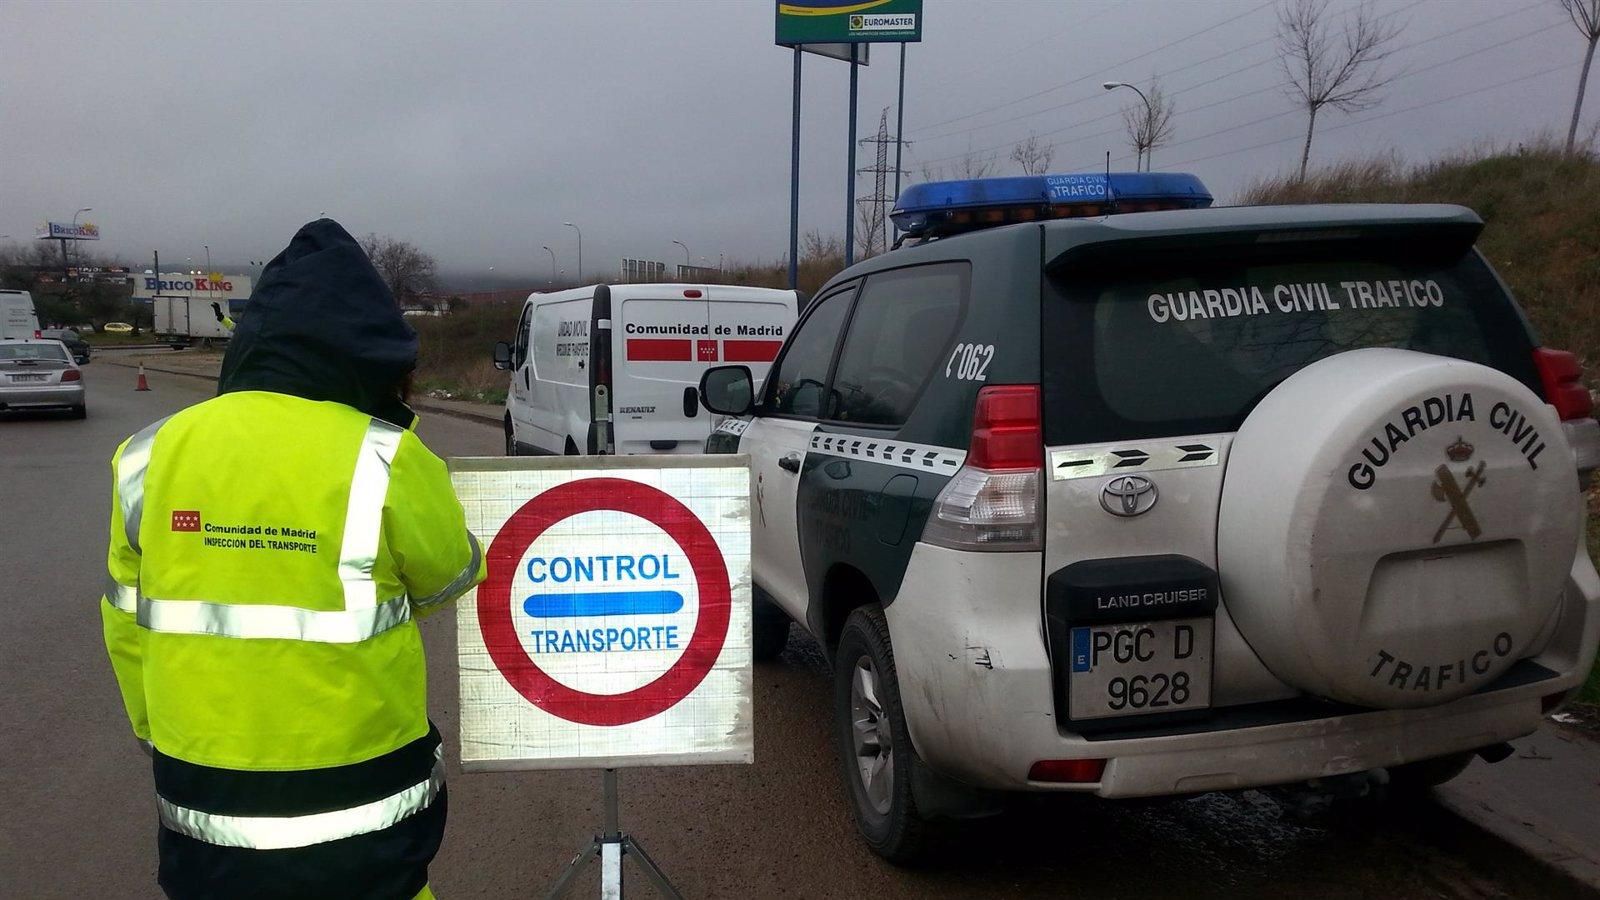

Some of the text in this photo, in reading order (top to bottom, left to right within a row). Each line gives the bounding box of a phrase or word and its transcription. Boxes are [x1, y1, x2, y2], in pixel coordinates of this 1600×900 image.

[864, 18, 913, 26] EUROMASTER
[1047, 176, 1107, 185] GUARDIA CIVIL
[1054, 185, 1104, 197] TRAFICO
[1148, 280, 1444, 323] GUARDIA CIVIL TRAFICO
[625, 323, 783, 336] Comunidad de Madrid
[957, 343, 995, 381] 062
[619, 406, 656, 414] RENAULT
[1347, 393, 1546, 490] GUARDIA CIVIL
[204, 523, 316, 539] Comunidad de Madrid
[249, 539, 266, 549] DEL
[267, 541, 317, 553] TRANSPORTE
[527, 554, 680, 583] CONTROL
[1097, 588, 1208, 609] LAND CRUISER
[531, 626, 679, 653] TRANSPORTE
[1092, 625, 1194, 666] PGC D
[1077, 654, 1086, 665] E
[1370, 632, 1513, 692] TRAFICO
[1107, 671, 1190, 710] 9628
